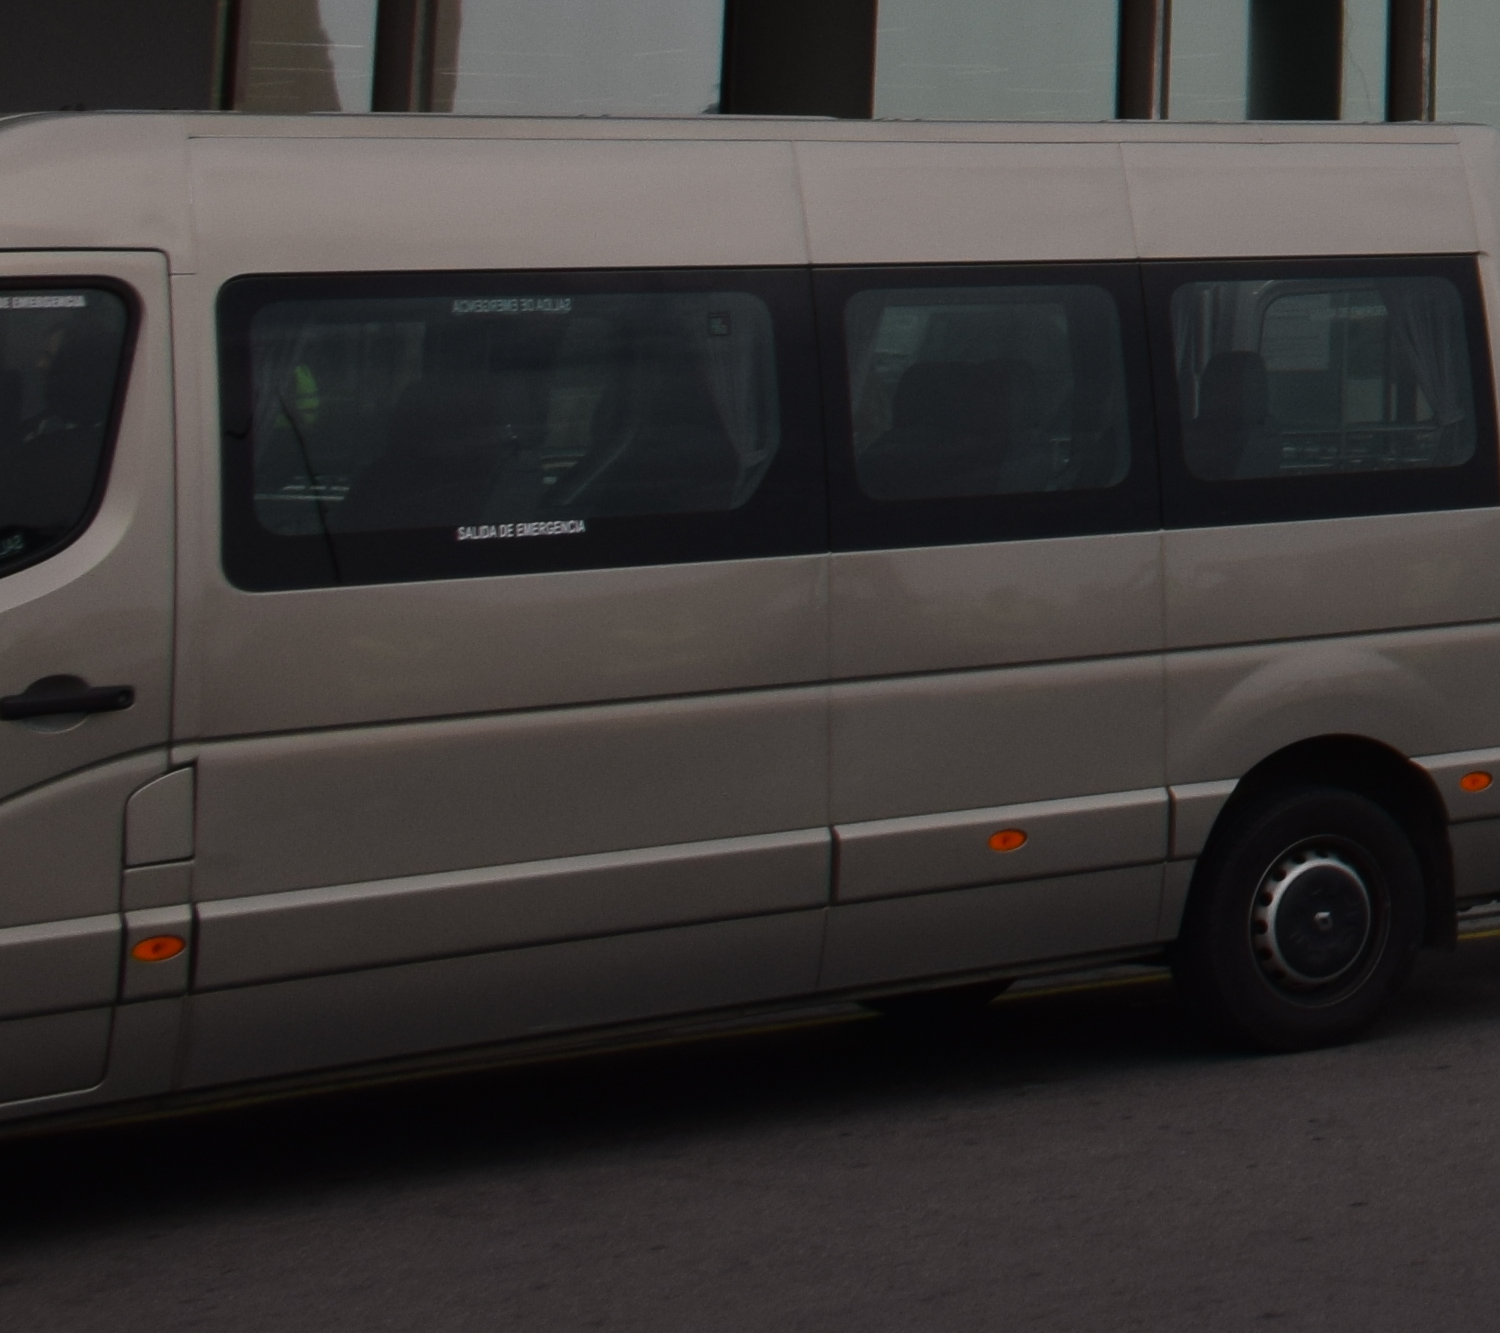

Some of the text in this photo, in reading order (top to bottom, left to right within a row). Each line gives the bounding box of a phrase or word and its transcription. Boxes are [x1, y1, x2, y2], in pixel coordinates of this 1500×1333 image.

[457, 520, 586, 541] SALIDA DE EMERGENCIA
